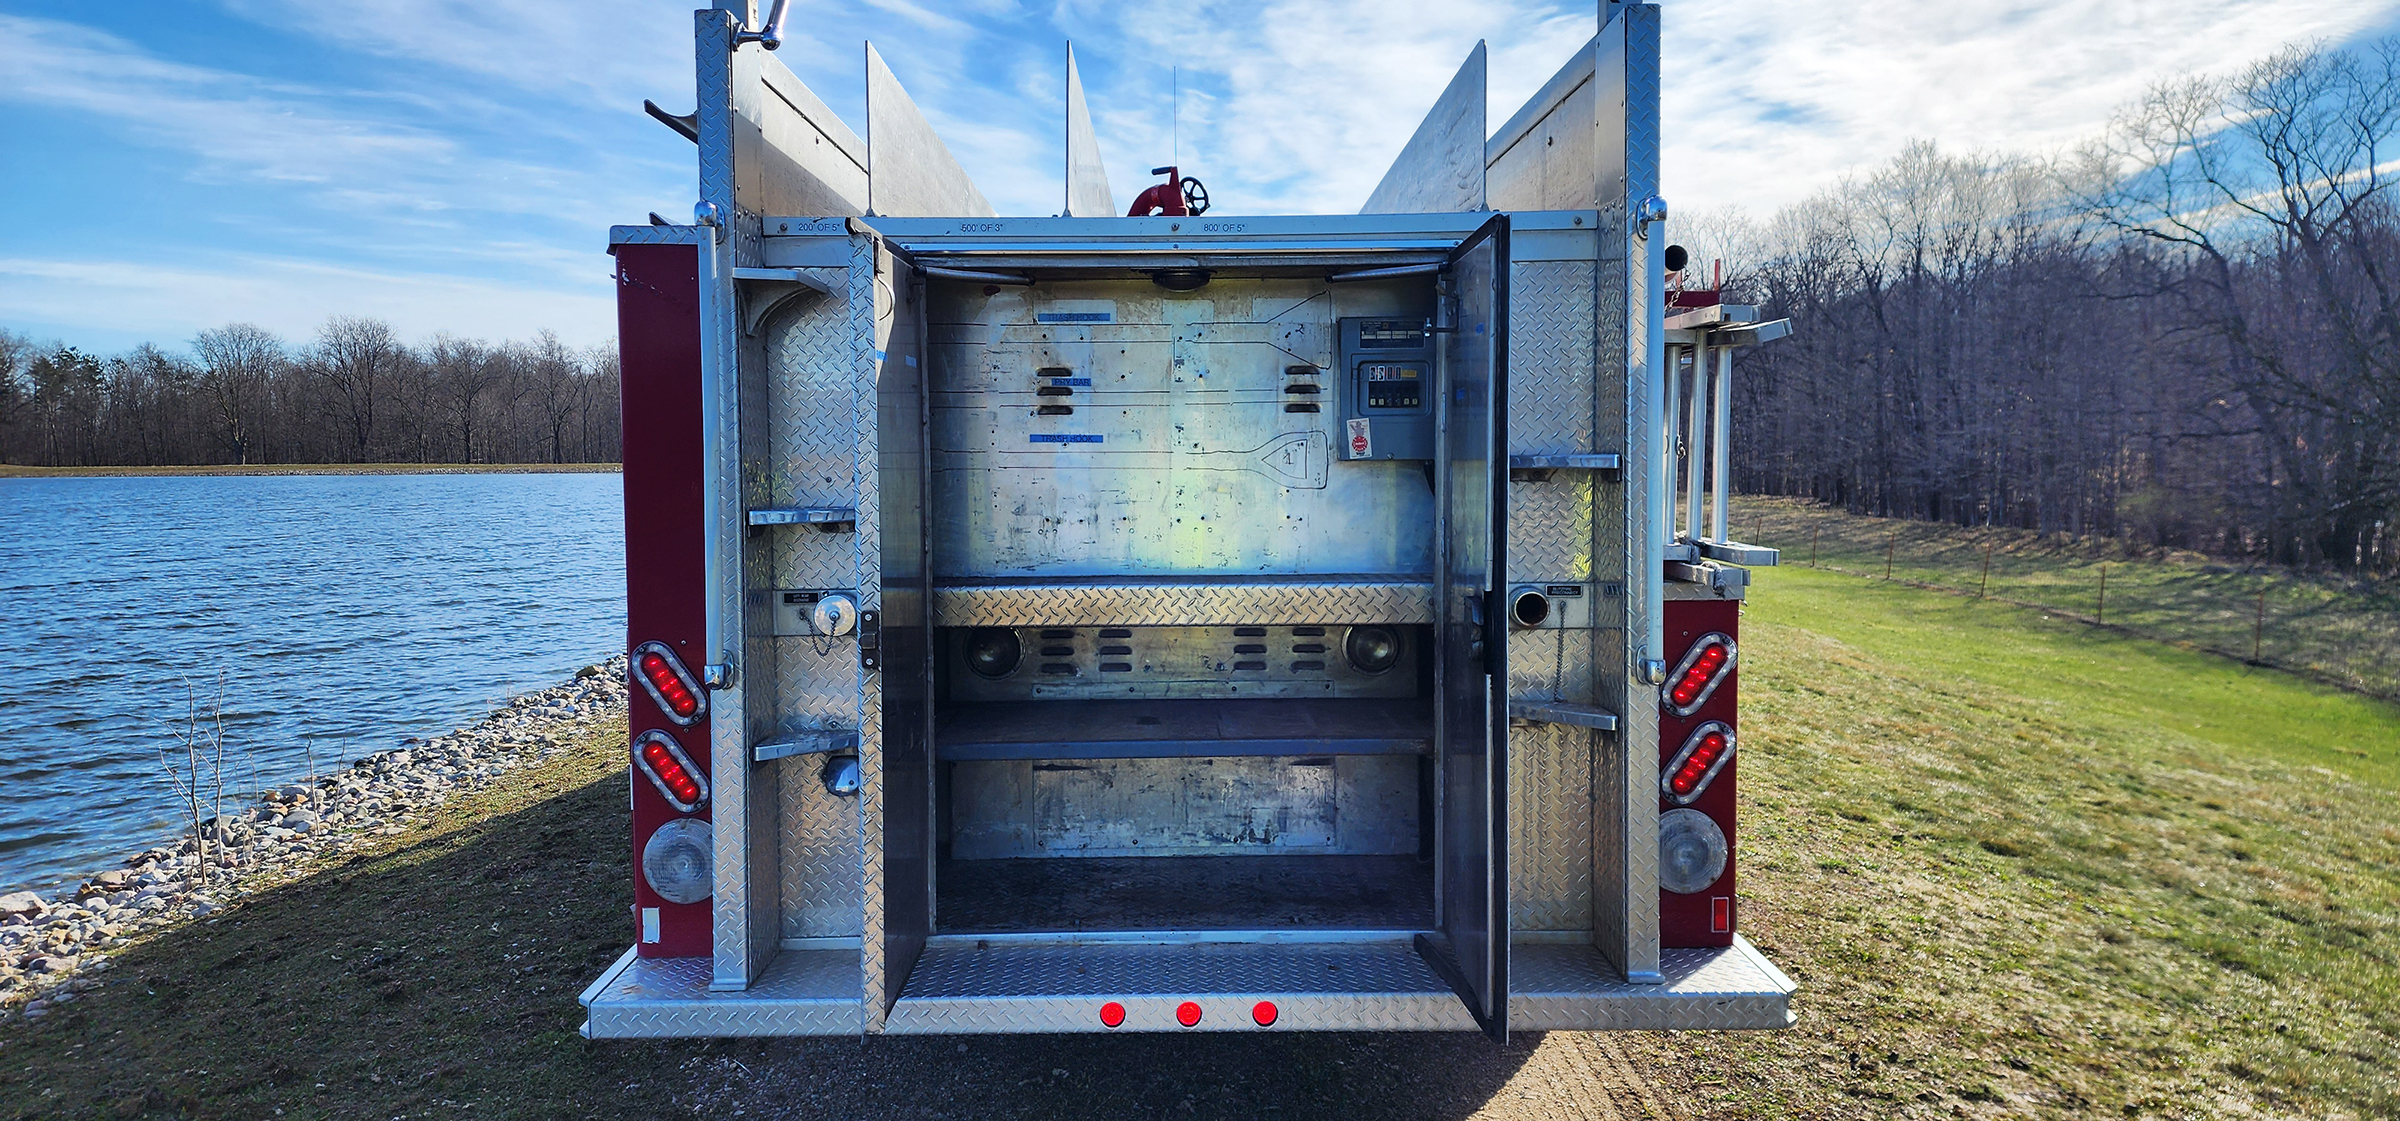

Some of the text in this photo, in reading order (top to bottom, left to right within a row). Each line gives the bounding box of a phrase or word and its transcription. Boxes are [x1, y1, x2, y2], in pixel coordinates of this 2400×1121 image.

[817, 223, 830, 232] OF
[980, 223, 992, 232] OF
[1222, 223, 1235, 232] OF
[1048, 313, 1074, 321] TRASH
[1054, 378, 1090, 386] PRY BAR
[1041, 434, 1093, 443] TRASH HOOK
